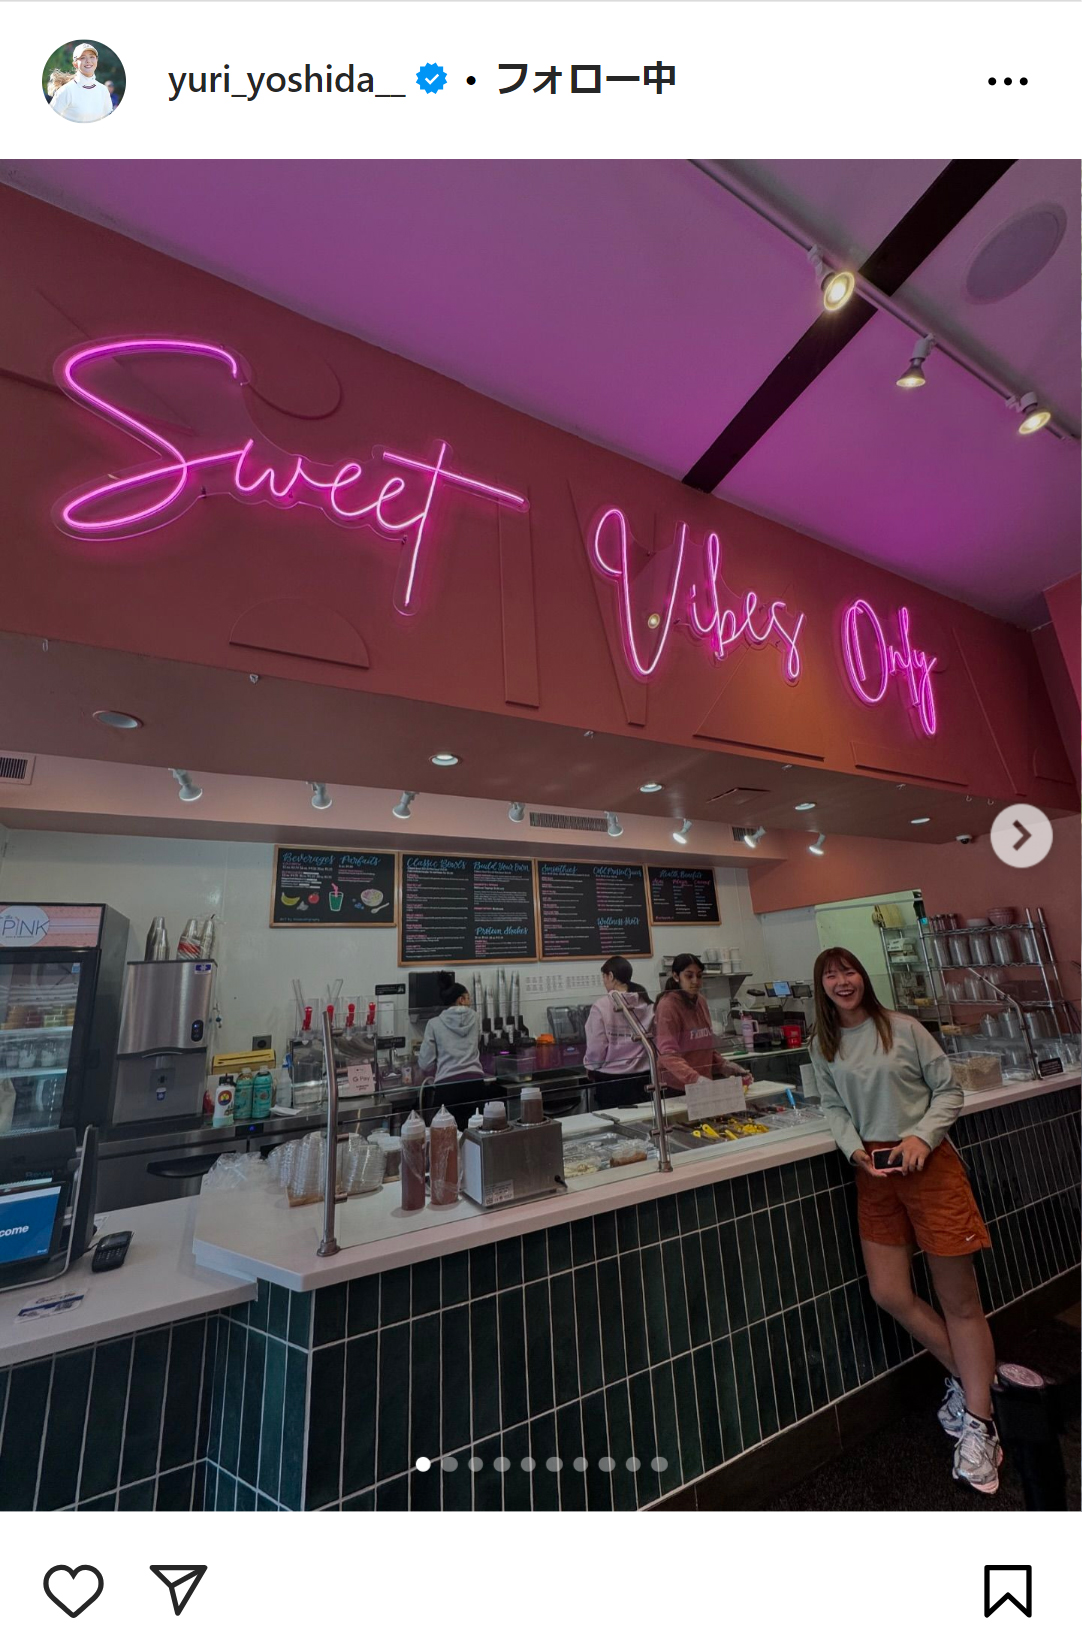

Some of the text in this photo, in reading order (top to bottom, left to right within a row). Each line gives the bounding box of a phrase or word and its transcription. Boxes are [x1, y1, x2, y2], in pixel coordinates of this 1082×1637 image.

[63, 340, 937, 735] Sweet Vibes Only
[283, 853, 335, 865] Beverages
[340, 855, 381, 866] Parfaits
[407, 857, 467, 869] Classic Bowls
[473, 862, 497, 870] Build
[541, 864, 578, 874] Smoothies
[2, 916, 50, 935] PINK
[597, 917, 623, 925] Wellness
[475, 926, 529, 935] Protein Shakes
